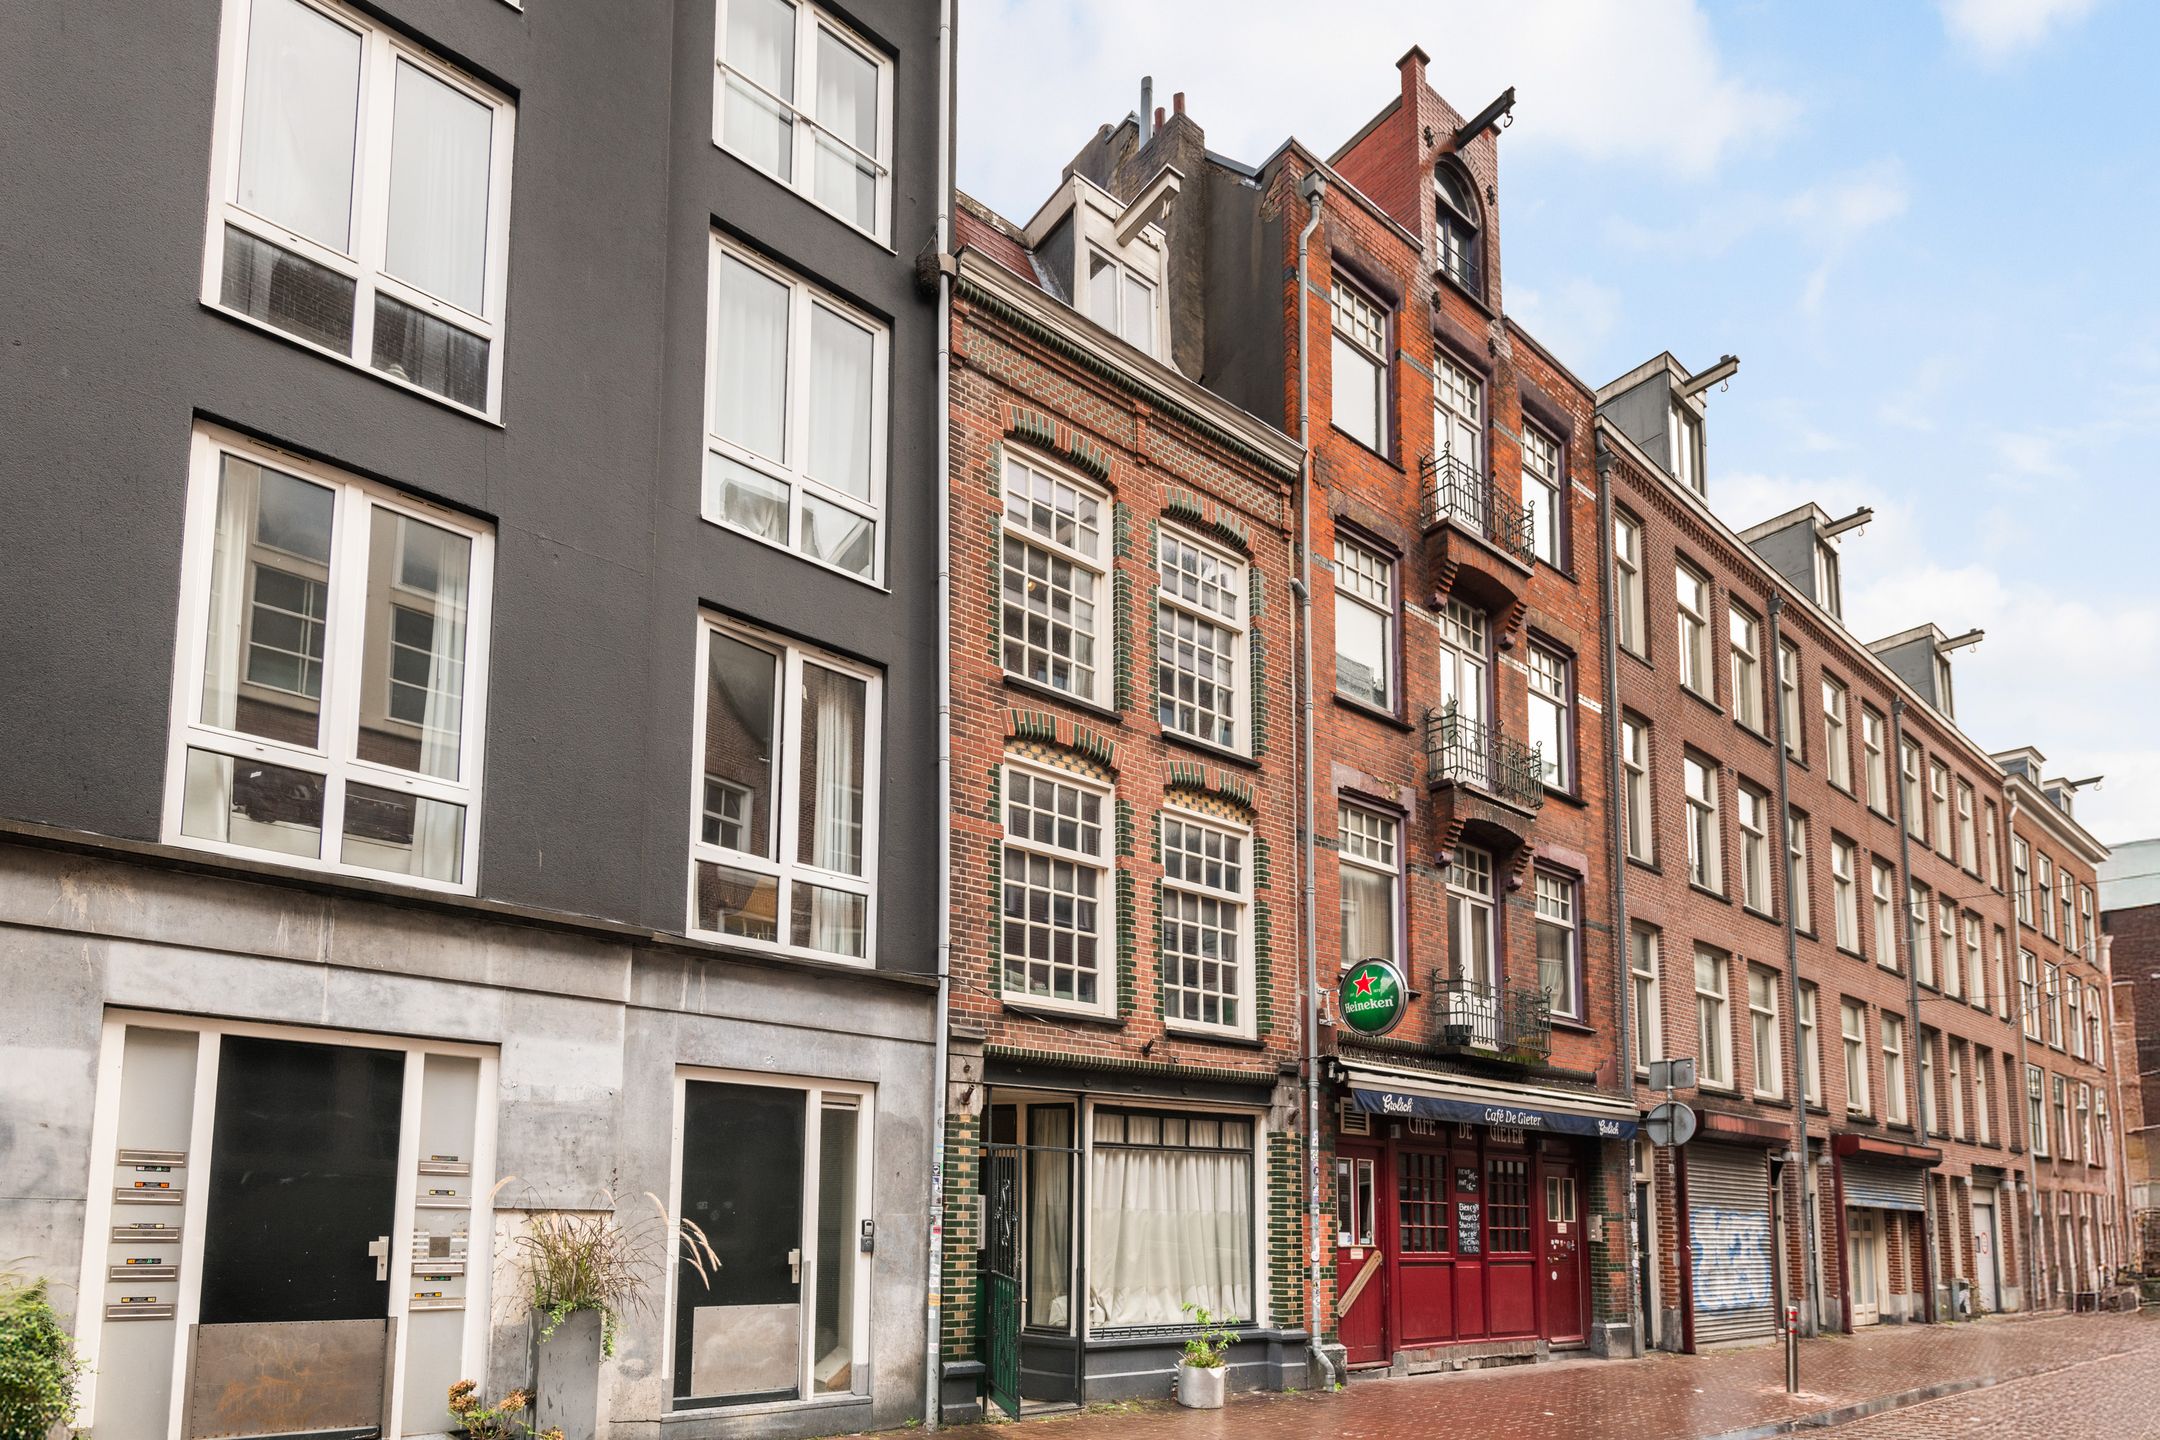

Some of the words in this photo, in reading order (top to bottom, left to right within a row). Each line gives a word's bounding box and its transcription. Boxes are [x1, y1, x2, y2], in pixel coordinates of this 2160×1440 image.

[1344, 998, 1394, 1013] Heineken
[1382, 1094, 1413, 1113] Grolsch
[1485, 1108, 1504, 1125] Café
[1505, 1110, 1517, 1124] De
[1518, 1112, 1542, 1126] Gieter
[1598, 1119, 1619, 1136] Grolsch
